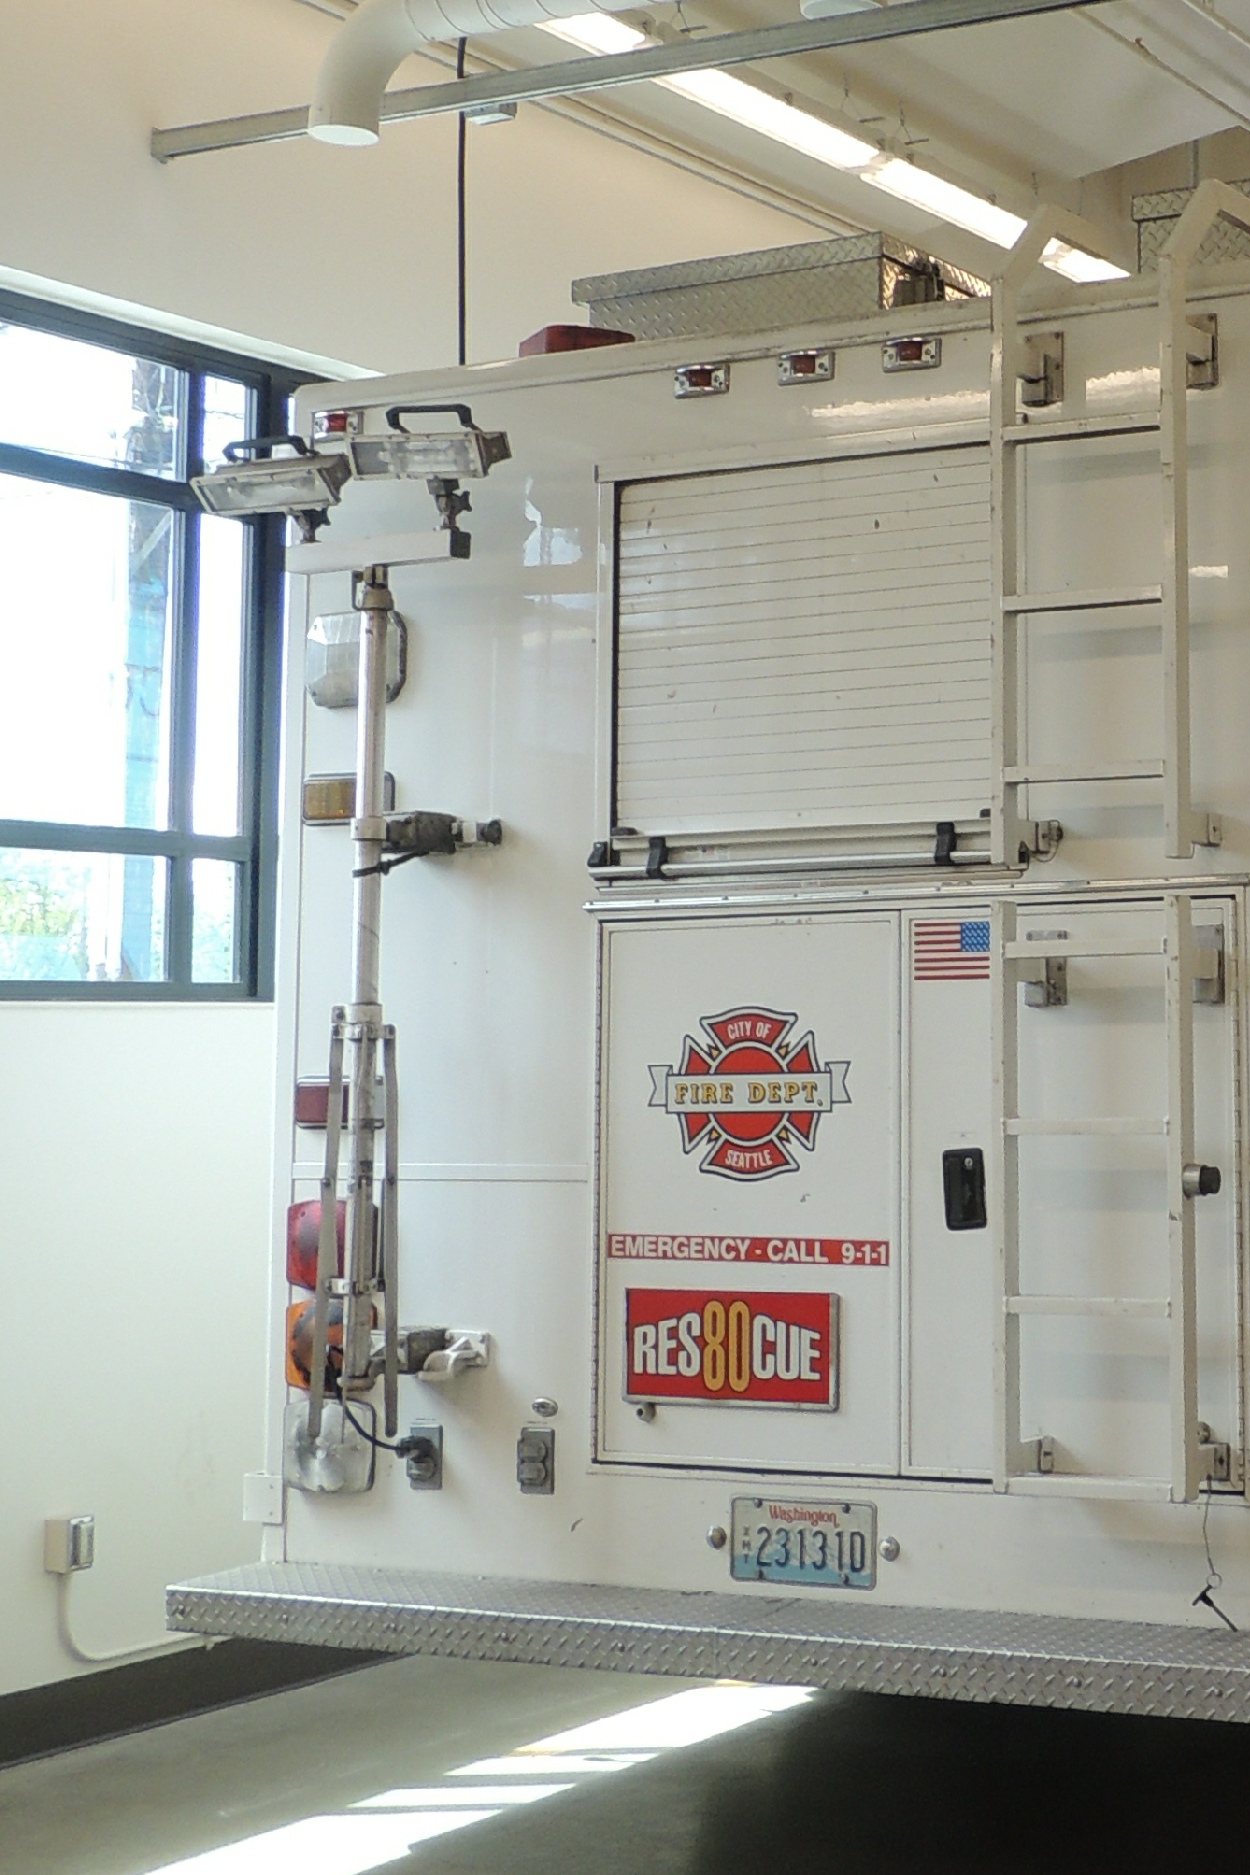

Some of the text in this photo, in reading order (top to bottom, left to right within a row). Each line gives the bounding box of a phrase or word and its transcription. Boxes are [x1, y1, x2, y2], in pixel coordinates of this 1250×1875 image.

[727, 1021, 772, 1040] CITY OF
[674, 1080, 824, 1107] FIRE DEPT.
[724, 1149, 773, 1169] SEATTLE
[611, 1235, 750, 1260] EMERGENCY
[766, 1239, 829, 1263] CALL
[768, 1504, 841, 1528] Washington
[756, 1526, 866, 1574] 231310
